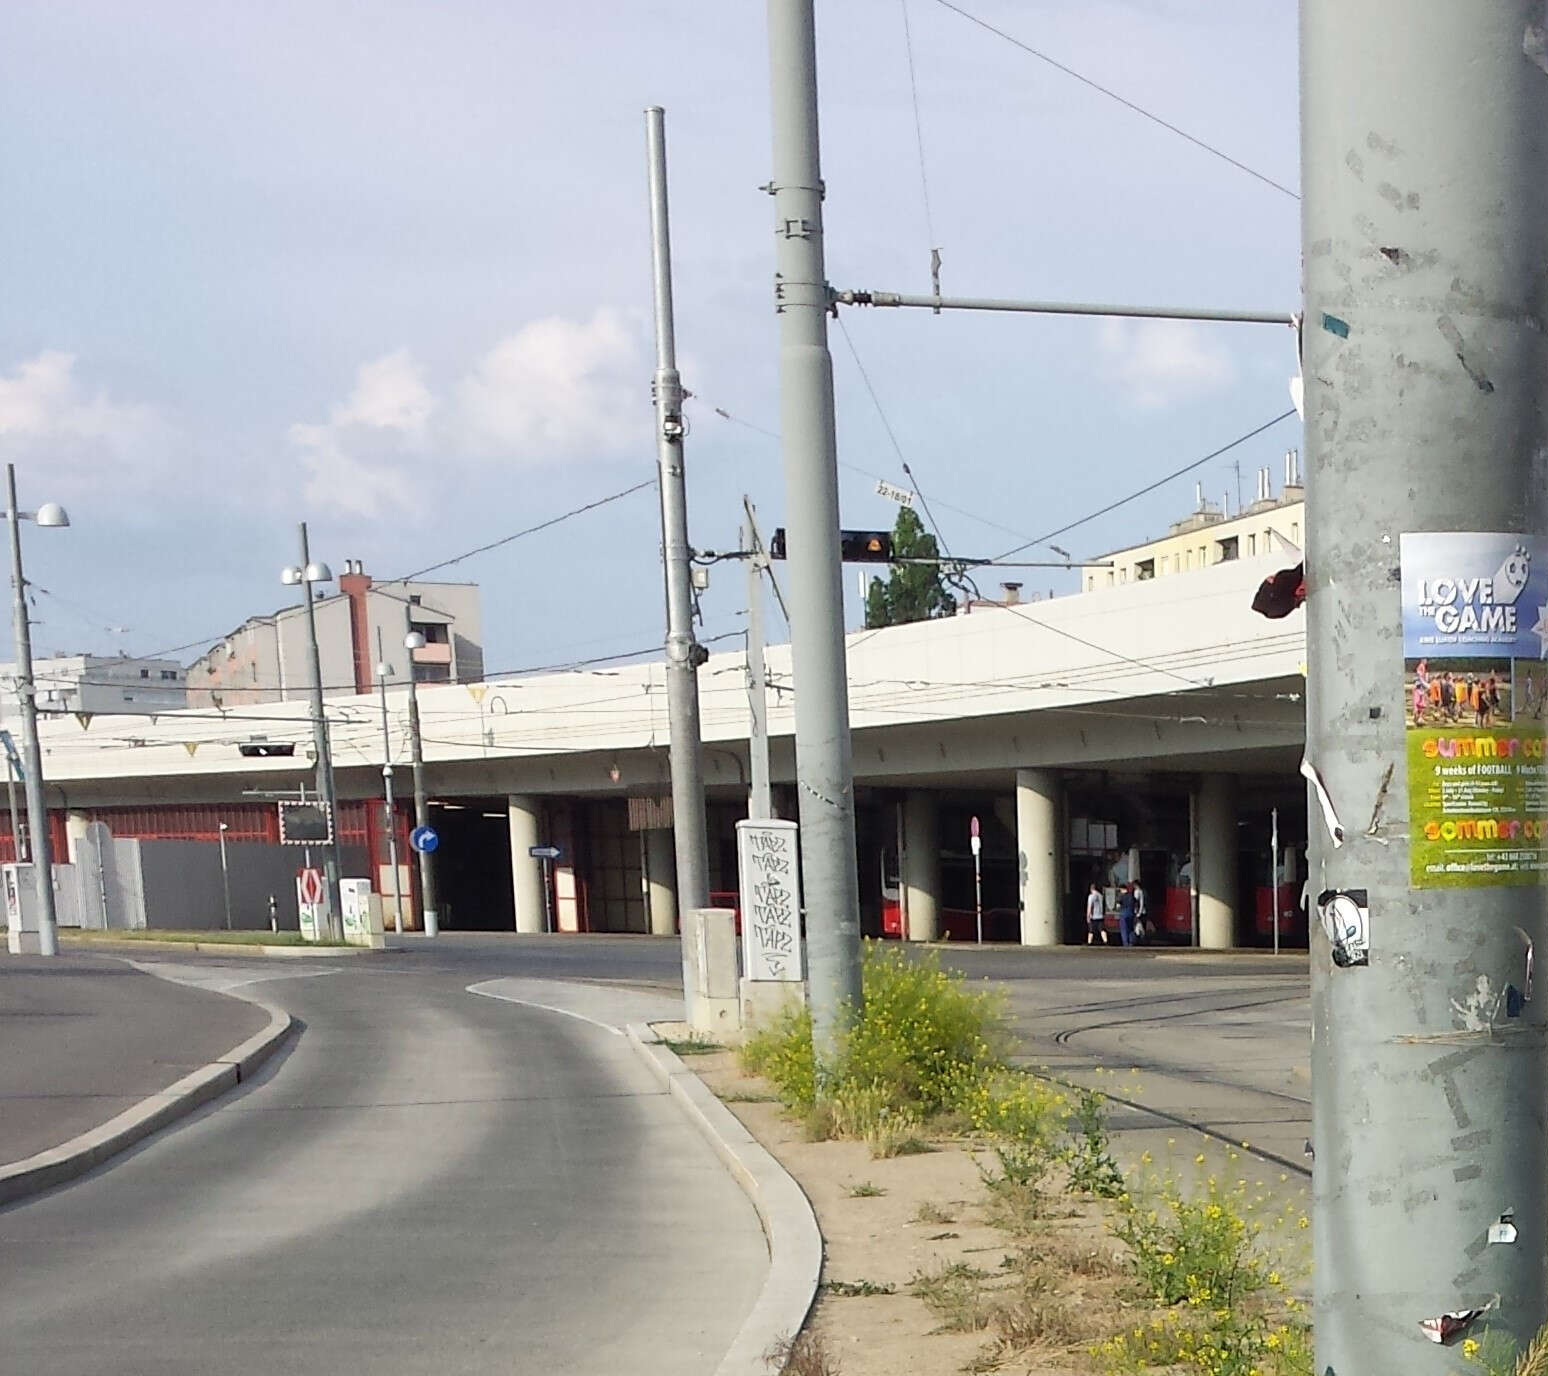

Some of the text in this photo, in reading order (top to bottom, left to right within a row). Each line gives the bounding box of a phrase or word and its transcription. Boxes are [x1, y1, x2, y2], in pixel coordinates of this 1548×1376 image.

[1417, 576, 1494, 606] LOVE
[1419, 606, 1436, 617] THE
[1435, 605, 1518, 634] GAME
[1423, 737, 1519, 759] summer
[1442, 765, 1467, 776] weeks
[1477, 765, 1511, 775] FOOTBALL
[1424, 819, 1520, 841] sommer
